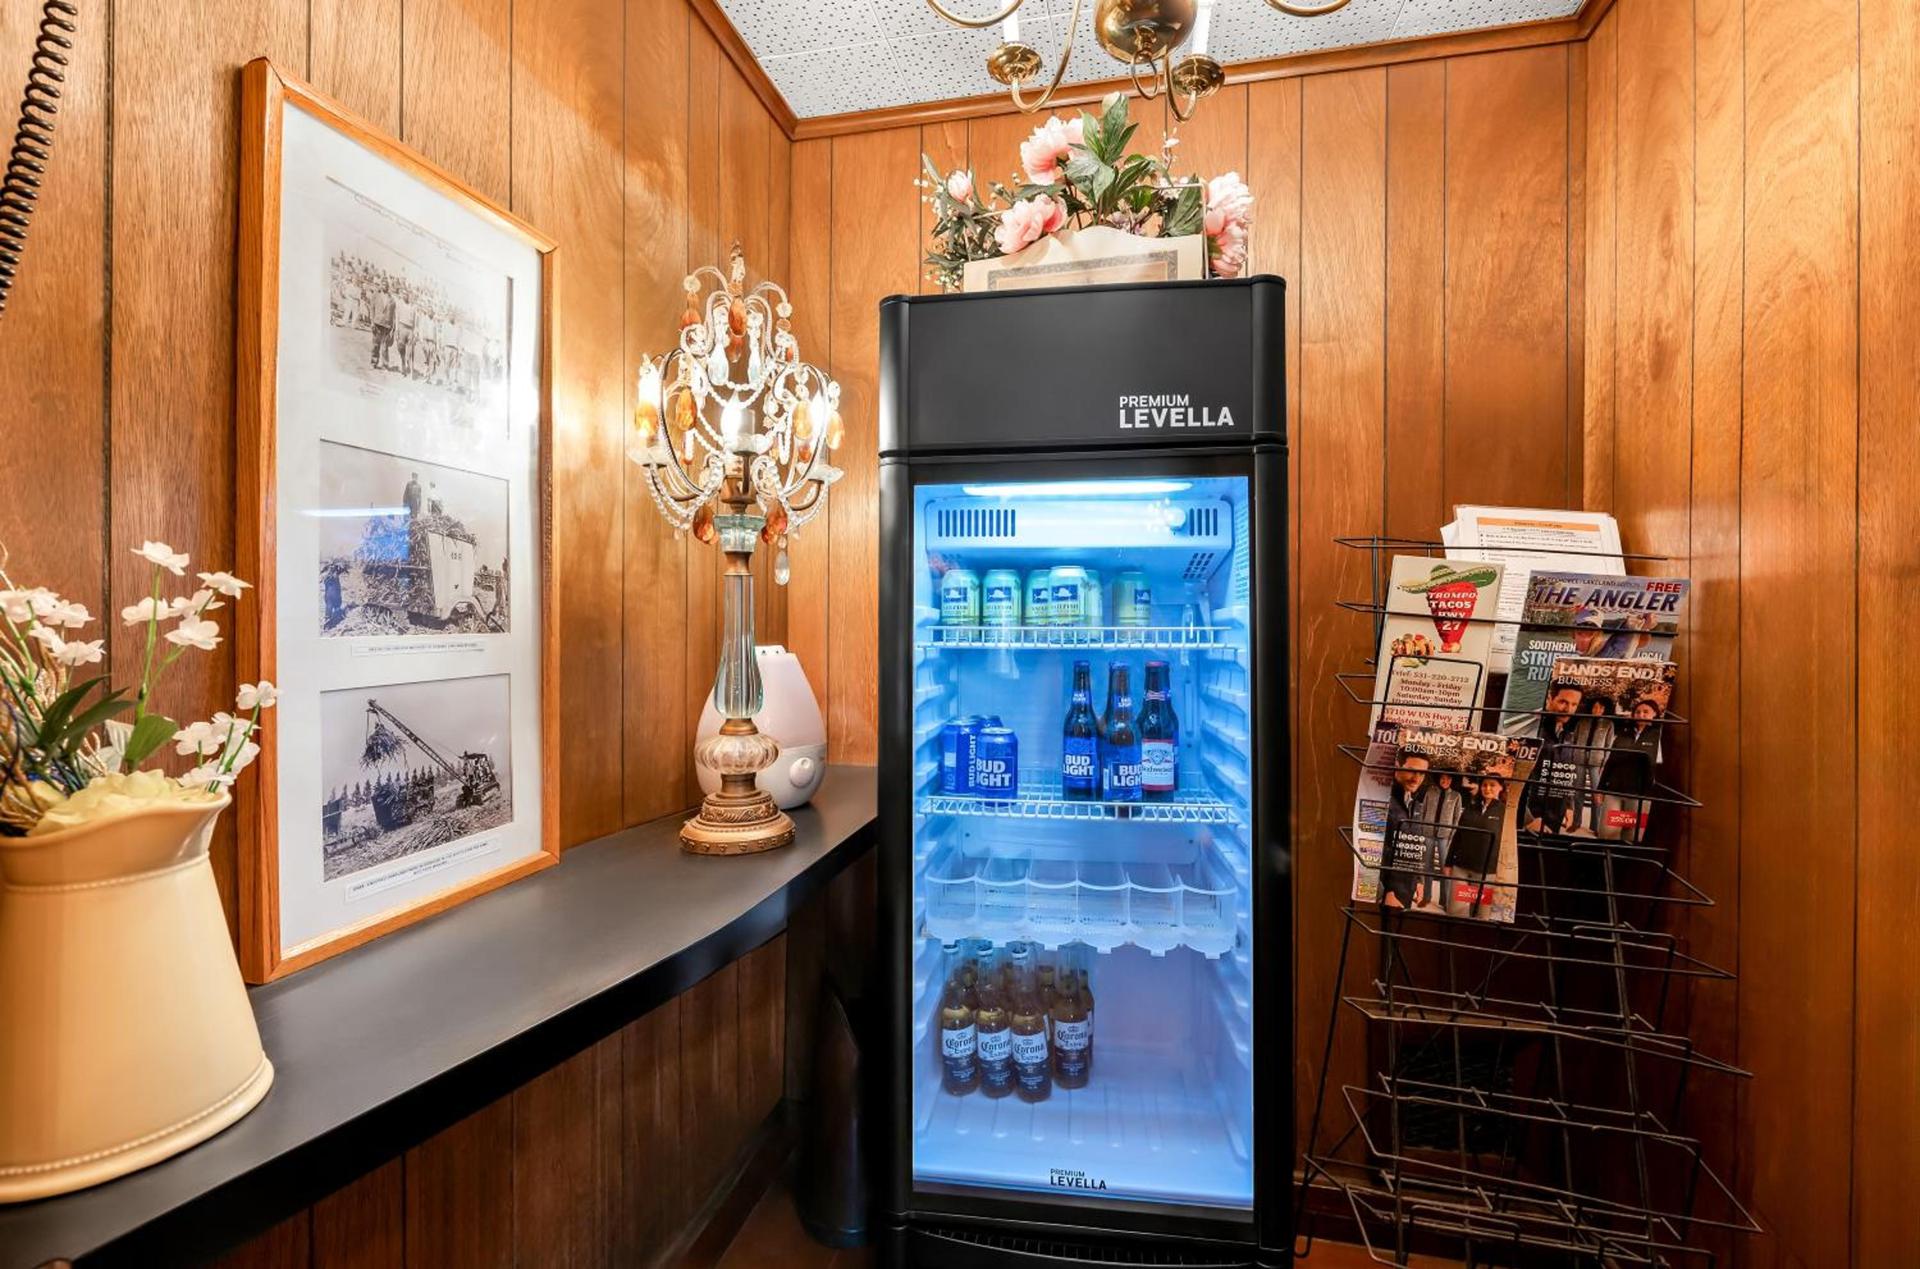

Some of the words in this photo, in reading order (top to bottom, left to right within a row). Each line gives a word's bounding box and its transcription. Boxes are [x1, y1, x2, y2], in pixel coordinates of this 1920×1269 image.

[1119, 394, 1189, 408] PREMIUM
[1119, 406, 1235, 428] LEVELLA
[1645, 582, 1682, 593] FREE
[1428, 590, 1478, 599] TROMPO
[1534, 586, 1580, 605] THE
[1584, 588, 1680, 612] ANGLER
[1430, 600, 1472, 609] TACOS
[1442, 620, 1461, 631] 27
[1529, 639, 1577, 652] SOUTHERN
[1637, 651, 1665, 662] LOCAL
[1617, 665, 1655, 680] END
[1401, 678, 1430, 688] Monday
[1437, 682, 1463, 692] Friday
[1557, 675, 1613, 687] BUSINESS
[1419, 711, 1431, 719] US
[1432, 713, 1453, 722] Hwy
[1404, 743, 1459, 757] BUSINESS
[1462, 737, 1499, 752] END
[976, 757, 1006, 773] BUD
[1065, 754, 1091, 766] BUD
[1063, 764, 1095, 776] LIGHT
[1057, 1029, 1088, 1043] Corona
[1013, 1041, 1045, 1055] Corona
[1049, 1167, 1086, 1178] PREMIUM
[1049, 1175, 1107, 1190] LEVELLA
